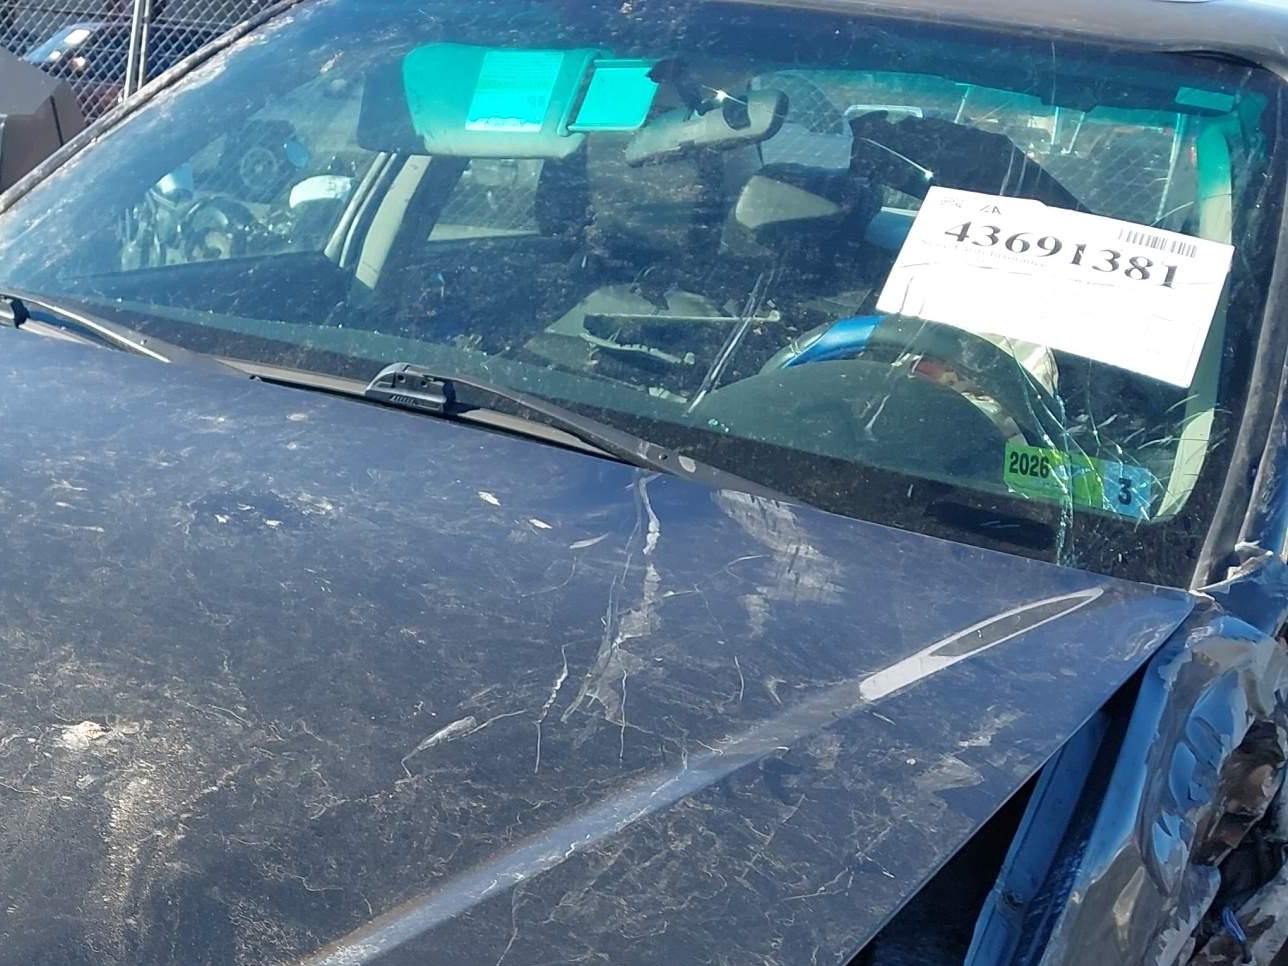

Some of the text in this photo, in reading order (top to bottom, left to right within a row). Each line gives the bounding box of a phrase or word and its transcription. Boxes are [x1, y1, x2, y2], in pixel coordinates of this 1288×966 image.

[944, 220, 1179, 289] 43691381
[1009, 451, 1050, 479] 2026
[1117, 477, 1133, 505] 3
